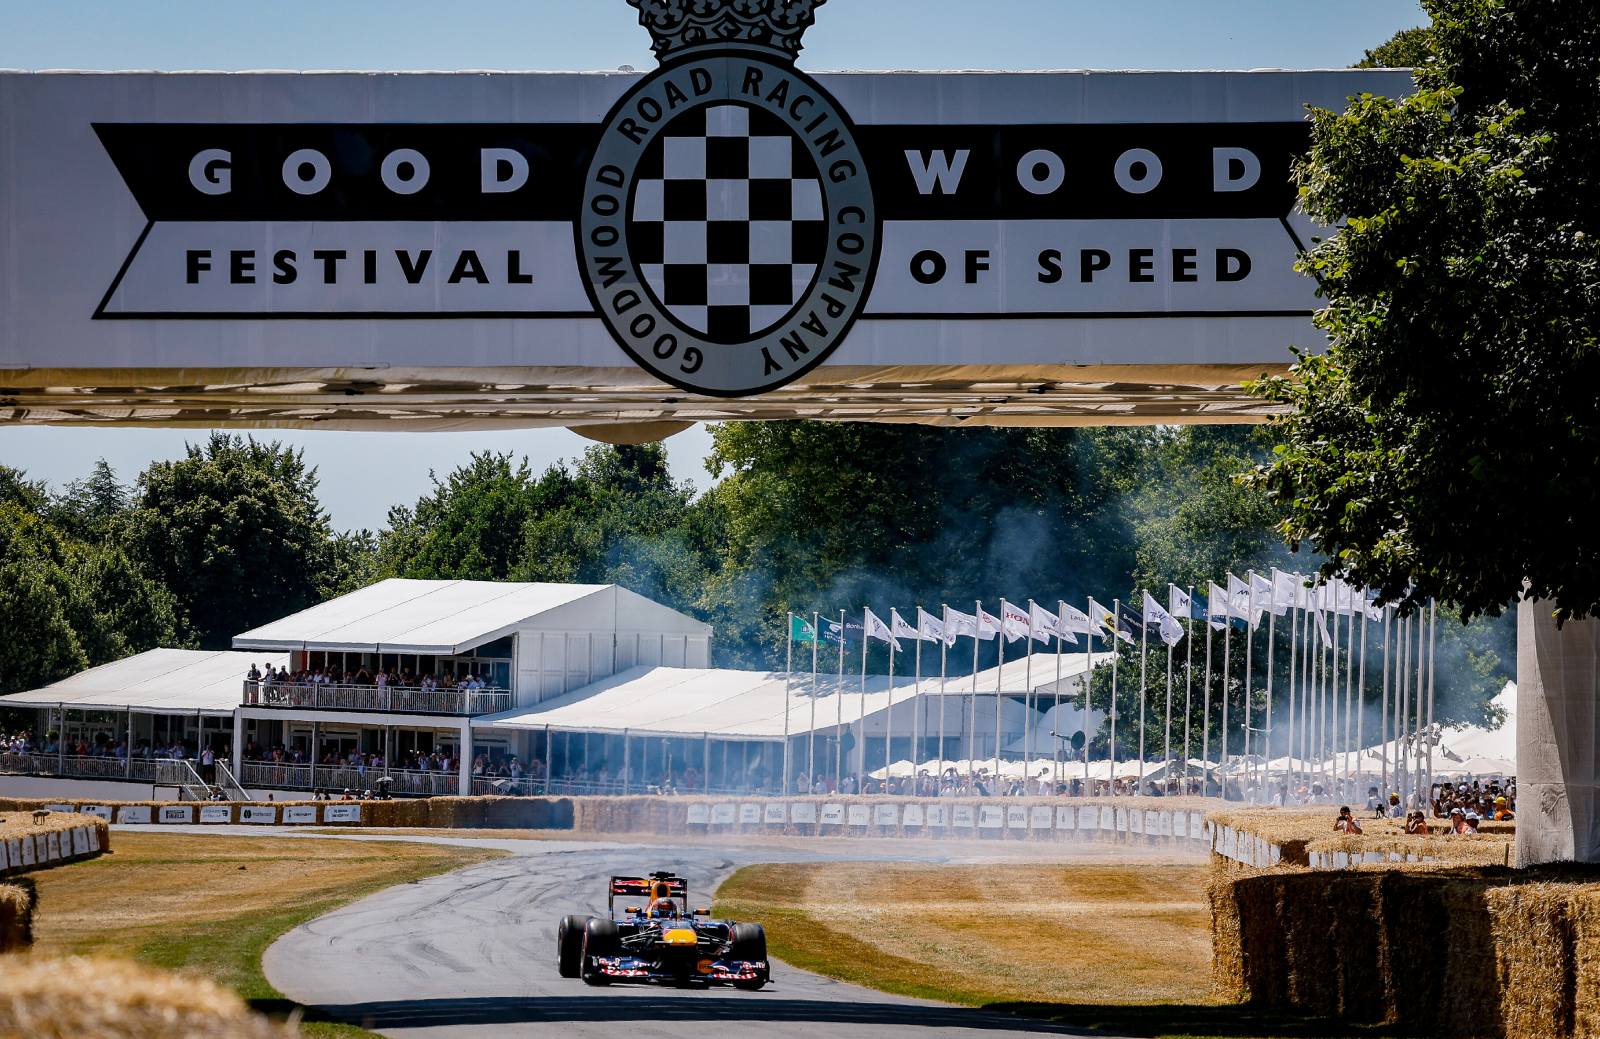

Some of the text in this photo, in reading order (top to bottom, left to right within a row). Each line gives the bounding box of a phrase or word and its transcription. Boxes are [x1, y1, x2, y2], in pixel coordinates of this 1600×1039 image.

[188, 147, 1261, 195] GOOD WOOD
[591, 66, 865, 376] GOODWOOD ROAD RACING COMPANY
[186, 248, 1252, 284] FESTIVAL OF SPEED
